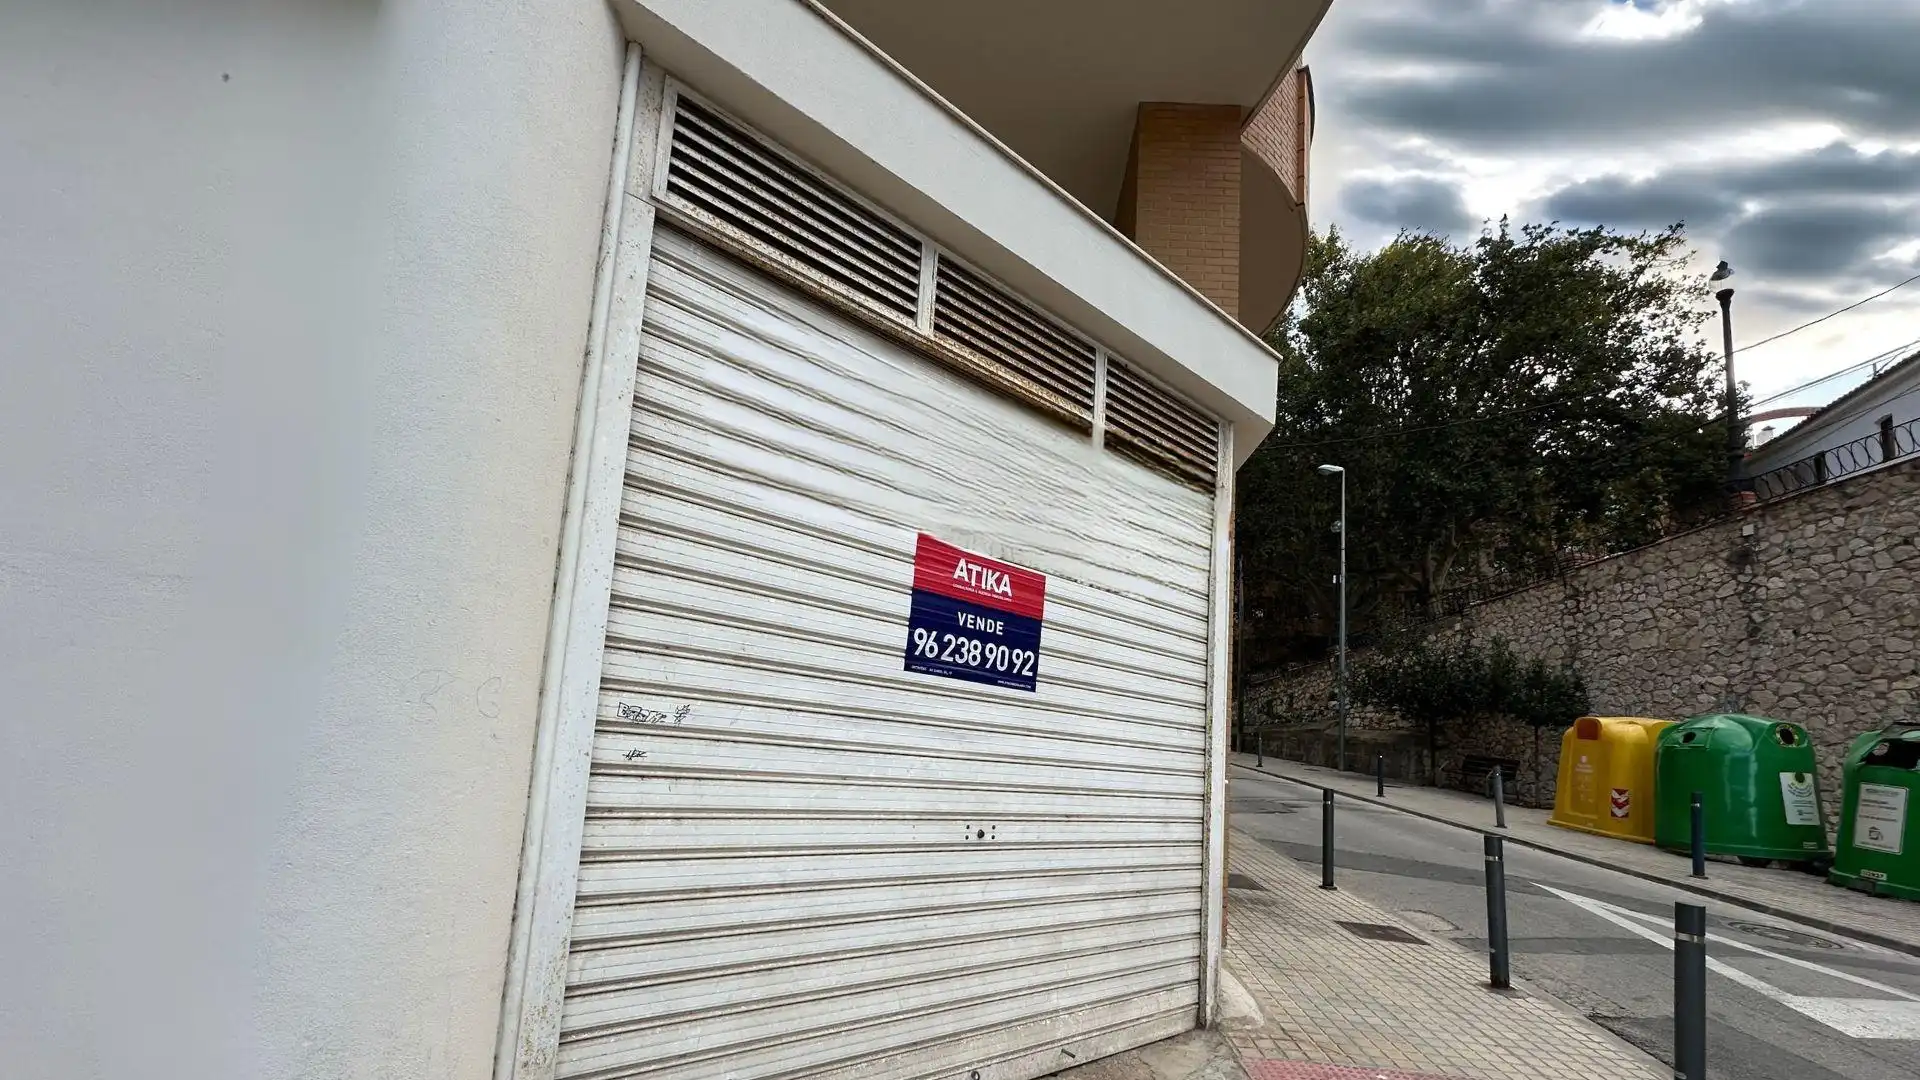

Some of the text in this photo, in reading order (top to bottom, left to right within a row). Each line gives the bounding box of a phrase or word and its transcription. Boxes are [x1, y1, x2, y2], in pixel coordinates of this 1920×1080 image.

[953, 558, 1013, 597] ATIKA
[957, 611, 1005, 636] VENDE
[913, 627, 939, 658] 96
[940, 634, 982, 667] 238
[985, 643, 1009, 672] 90
[1012, 648, 1035, 677] 92
